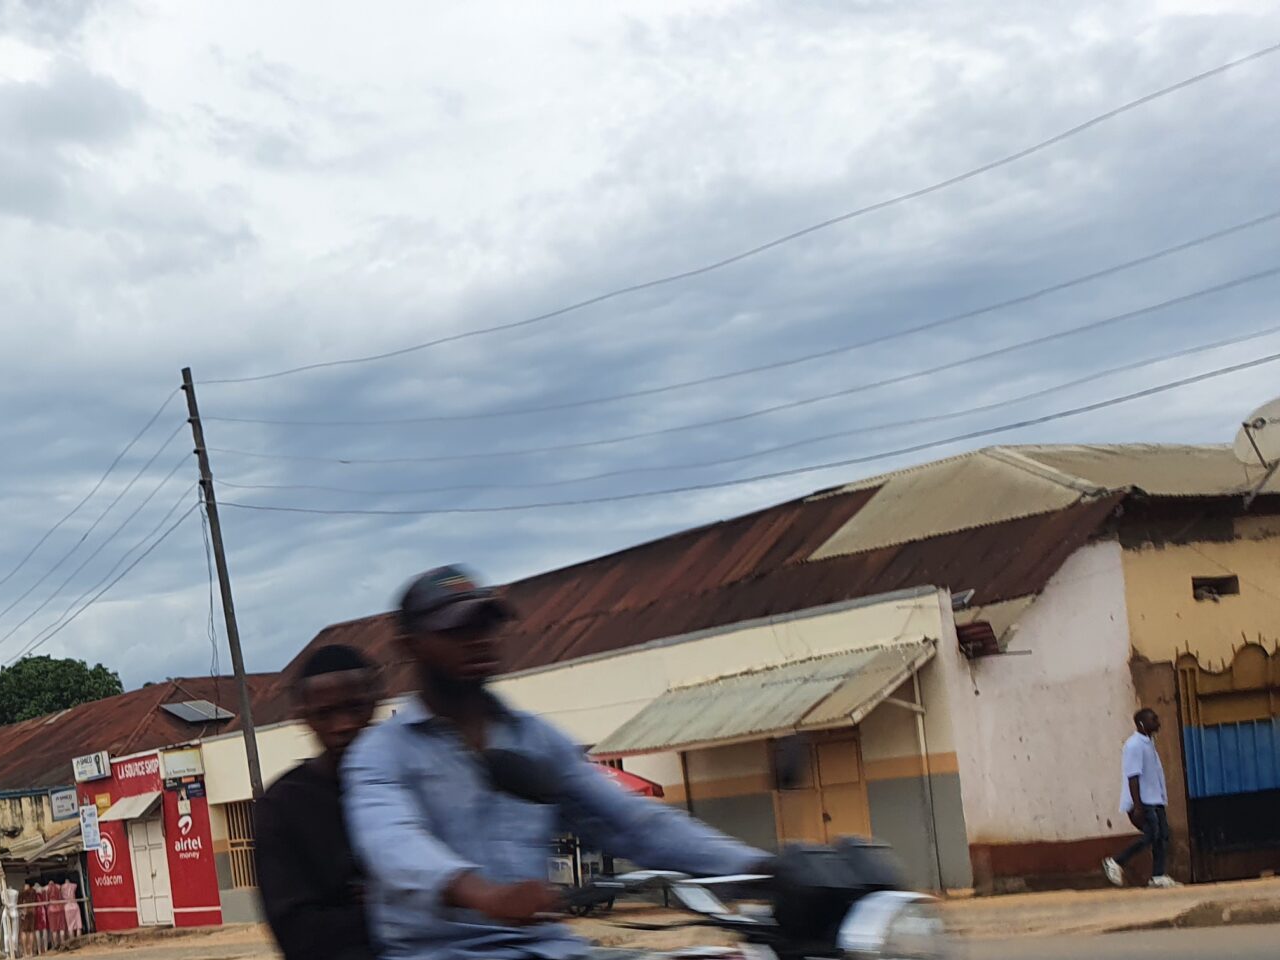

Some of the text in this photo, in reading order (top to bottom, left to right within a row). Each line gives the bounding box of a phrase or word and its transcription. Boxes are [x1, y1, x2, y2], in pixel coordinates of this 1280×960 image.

[117, 759, 159, 780] LA SOURCE SHOP
[175, 835, 203, 852] airtel
[179, 851, 200, 860] money
[95, 874, 123, 887] vodacom
